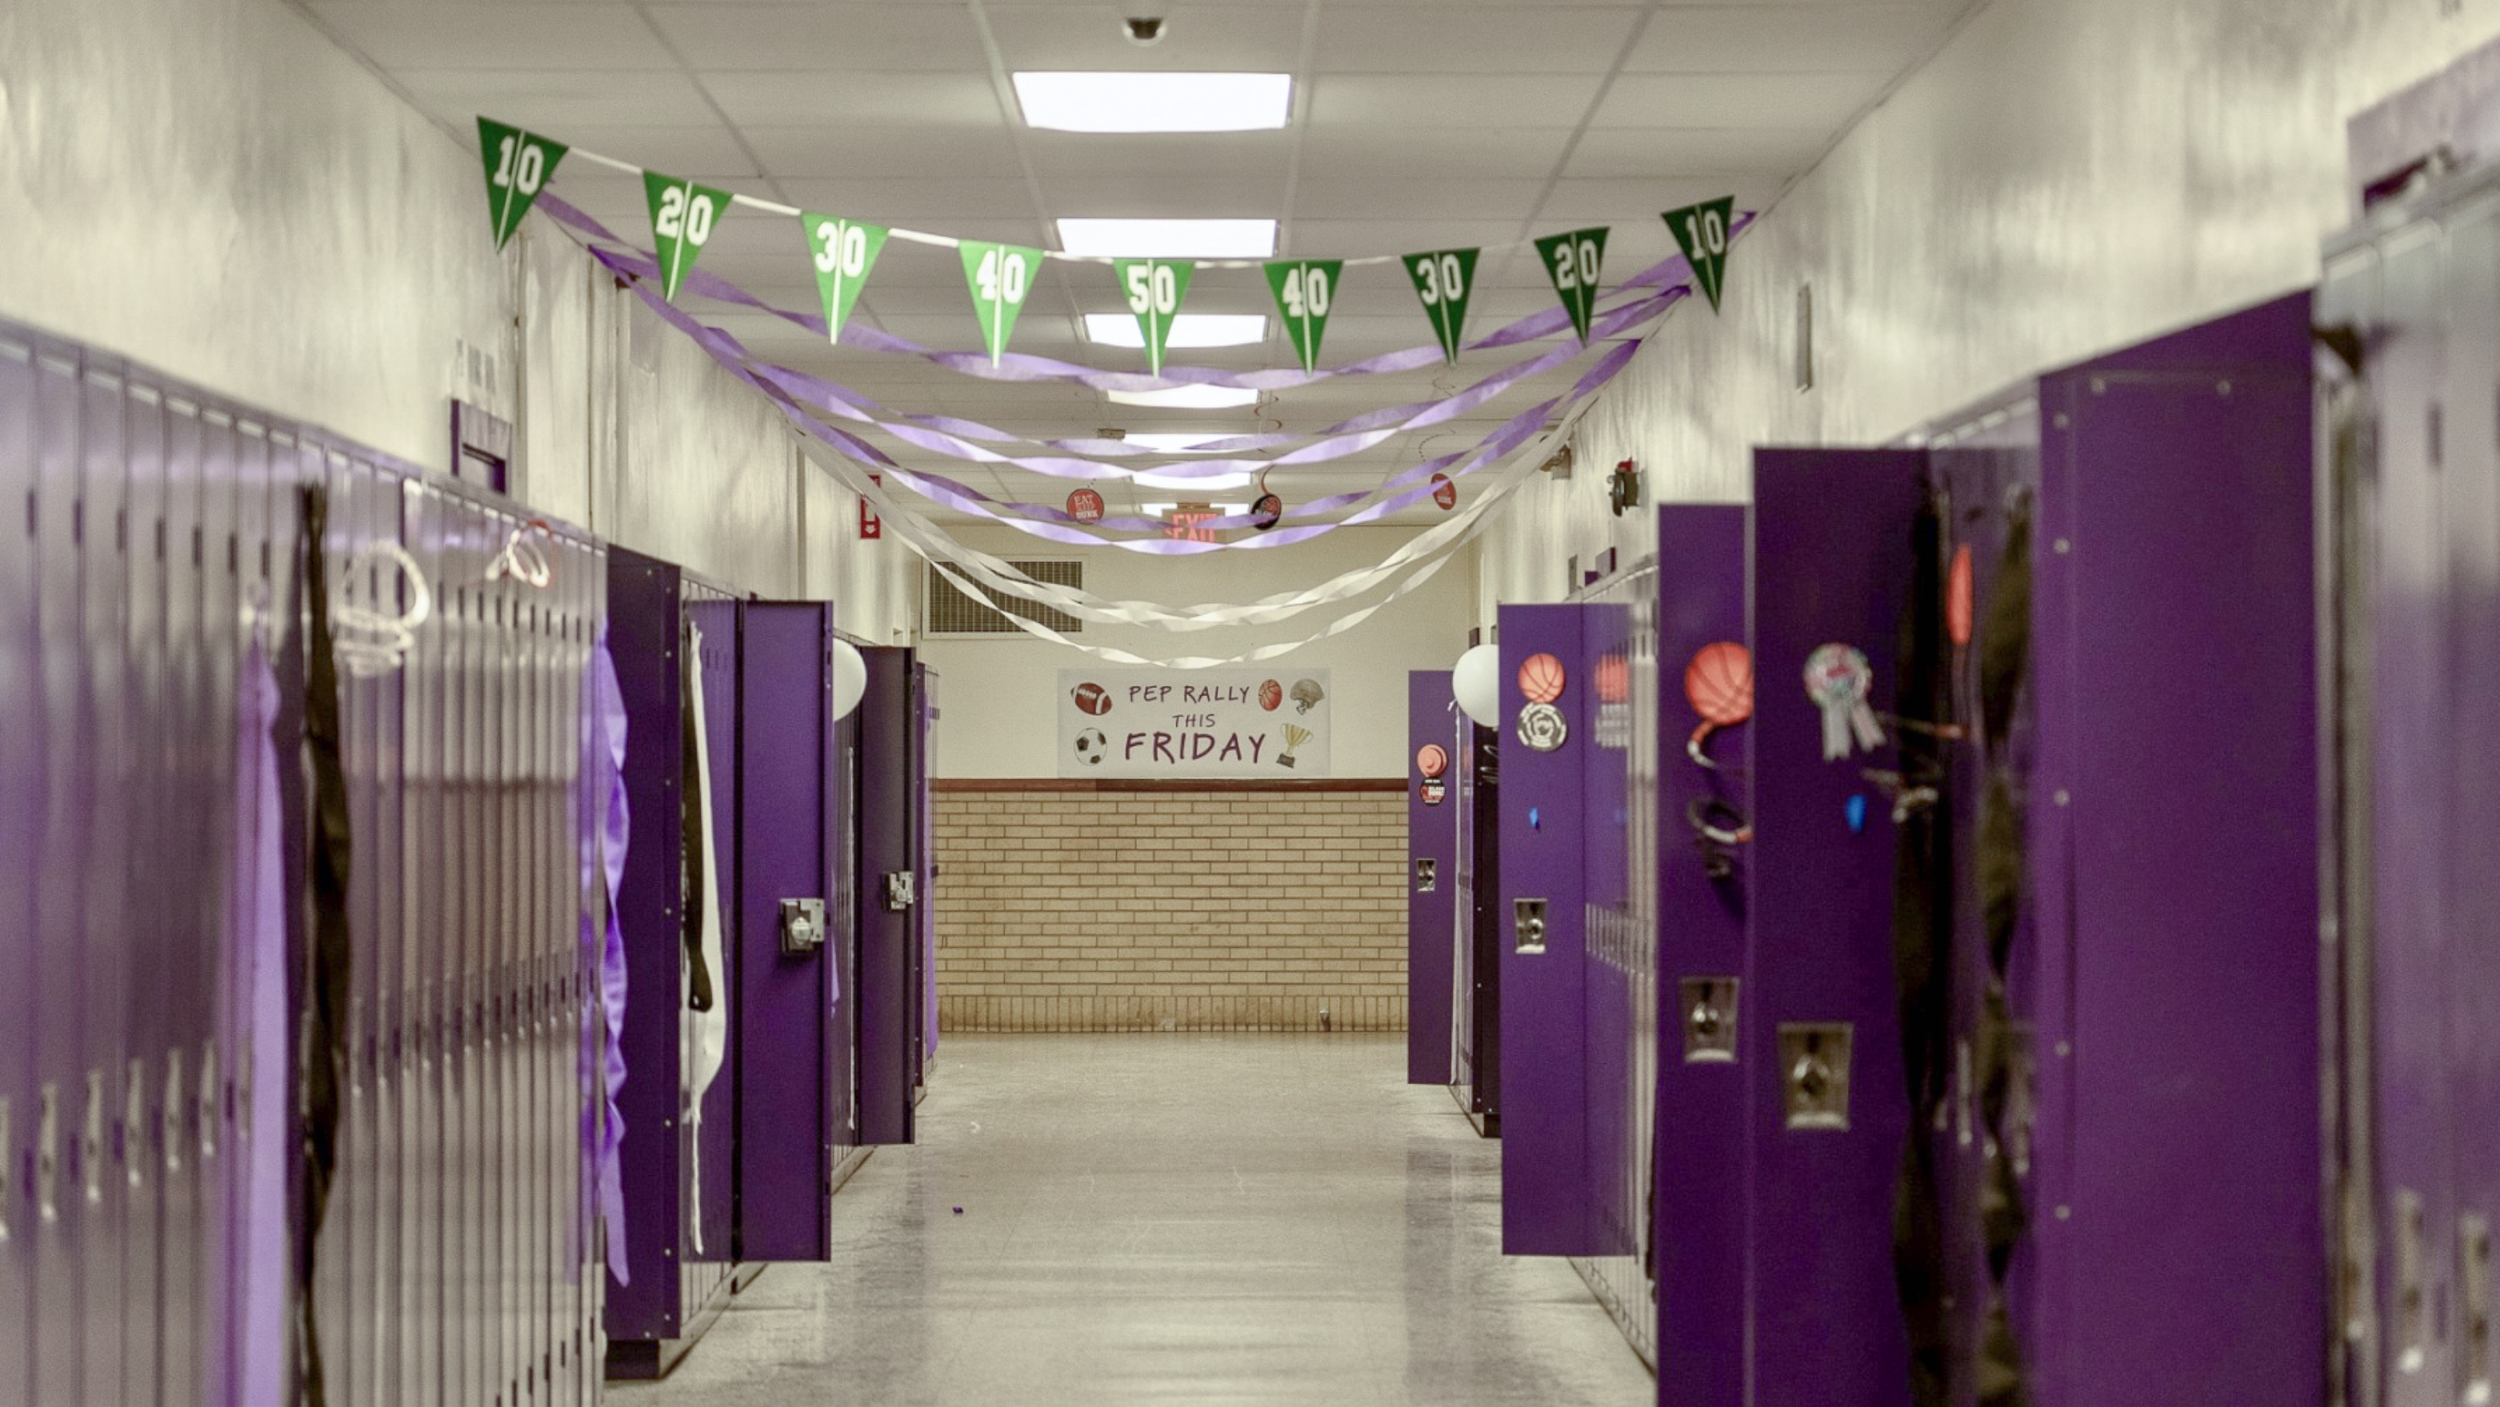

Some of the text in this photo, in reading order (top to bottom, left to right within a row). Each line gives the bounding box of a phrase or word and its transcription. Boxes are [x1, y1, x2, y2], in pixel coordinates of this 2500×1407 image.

[493, 135, 545, 195] 10
[655, 185, 714, 246] 20
[1685, 209, 1727, 259] 10
[814, 220, 867, 279] 30
[1554, 239, 1597, 290] 20
[976, 250, 1027, 305] 40
[1127, 264, 1178, 316] 50
[1281, 267, 1329, 318] 40
[1419, 253, 1464, 306] 30
[1129, 686, 1250, 704] PEP RALLY
[1172, 713, 1216, 729] THIS
[1125, 732, 1266, 764] FRIDAY
